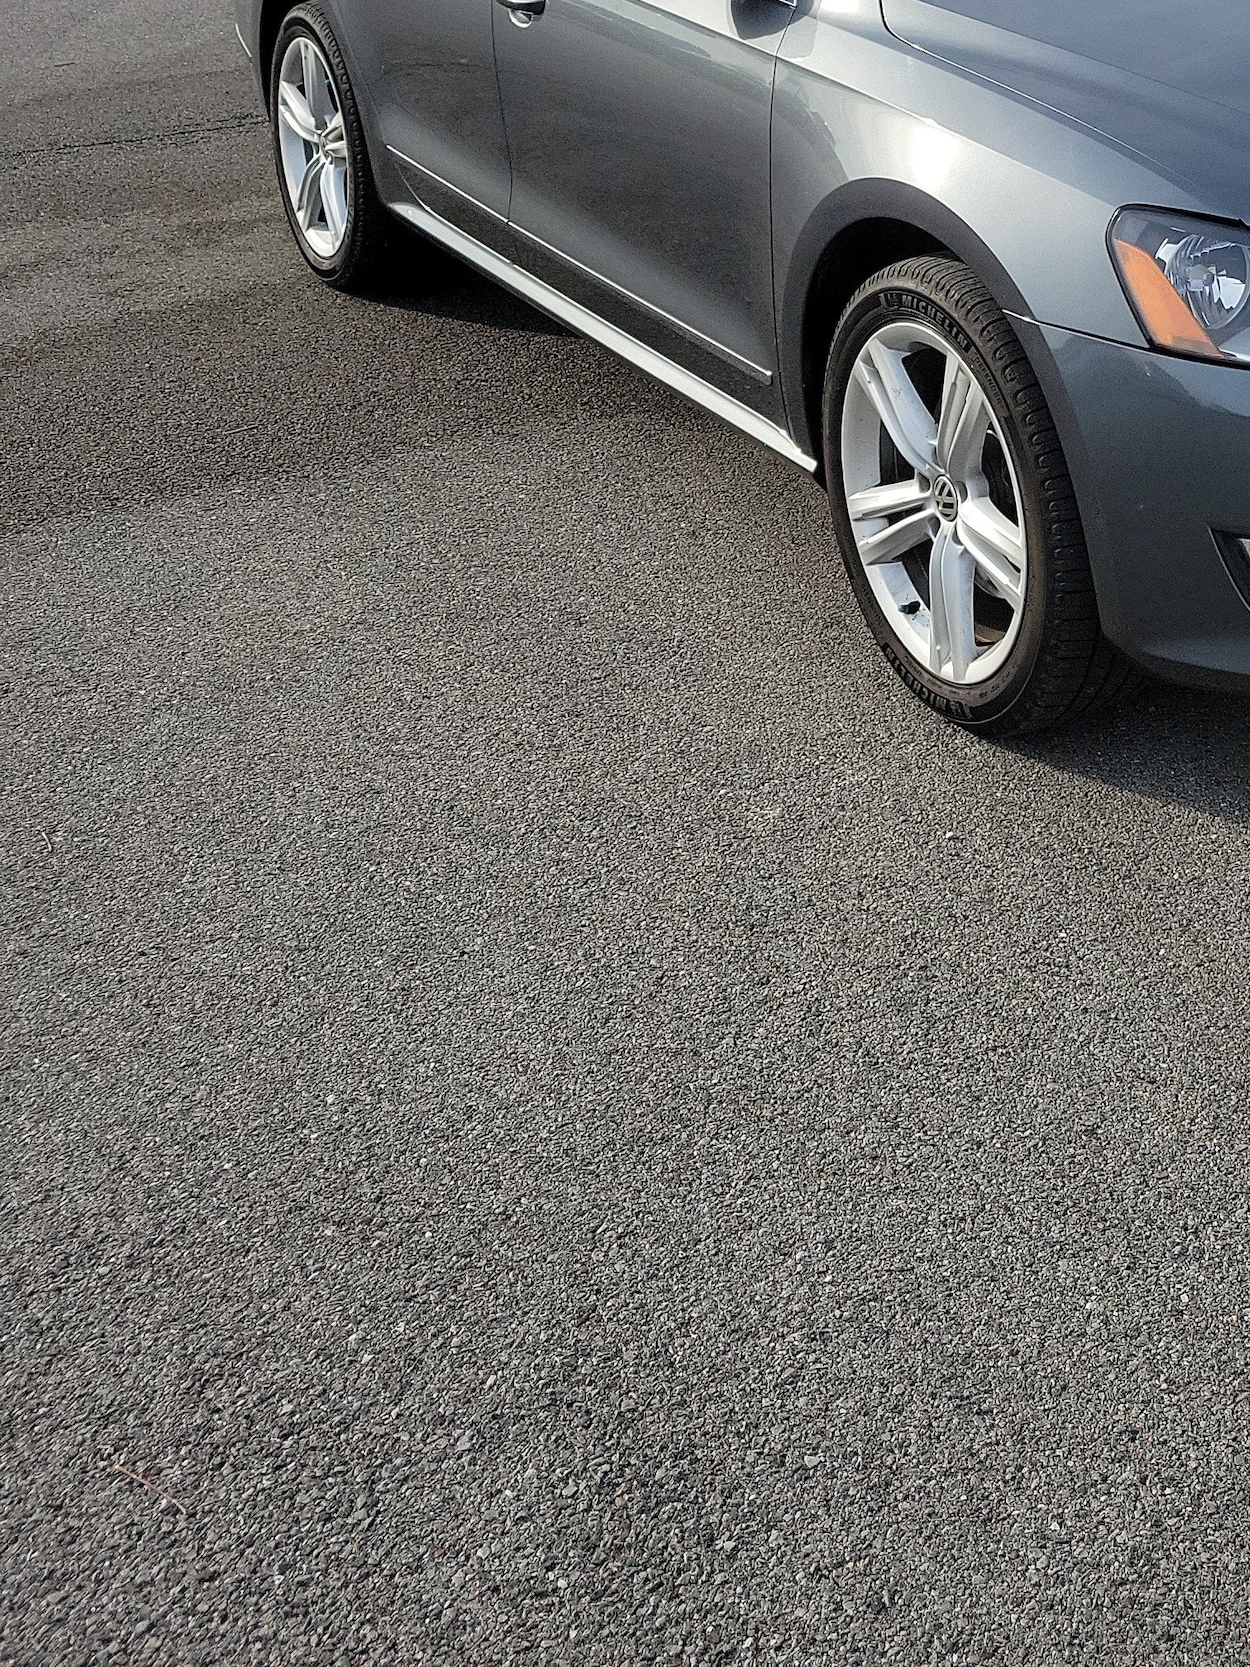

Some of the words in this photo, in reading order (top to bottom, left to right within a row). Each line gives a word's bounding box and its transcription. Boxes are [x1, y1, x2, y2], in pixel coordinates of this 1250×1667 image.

[902, 294, 969, 348] MICHELIN
[972, 355, 1004, 405] DEFENDER
[884, 646, 948, 712] MICHELIN
